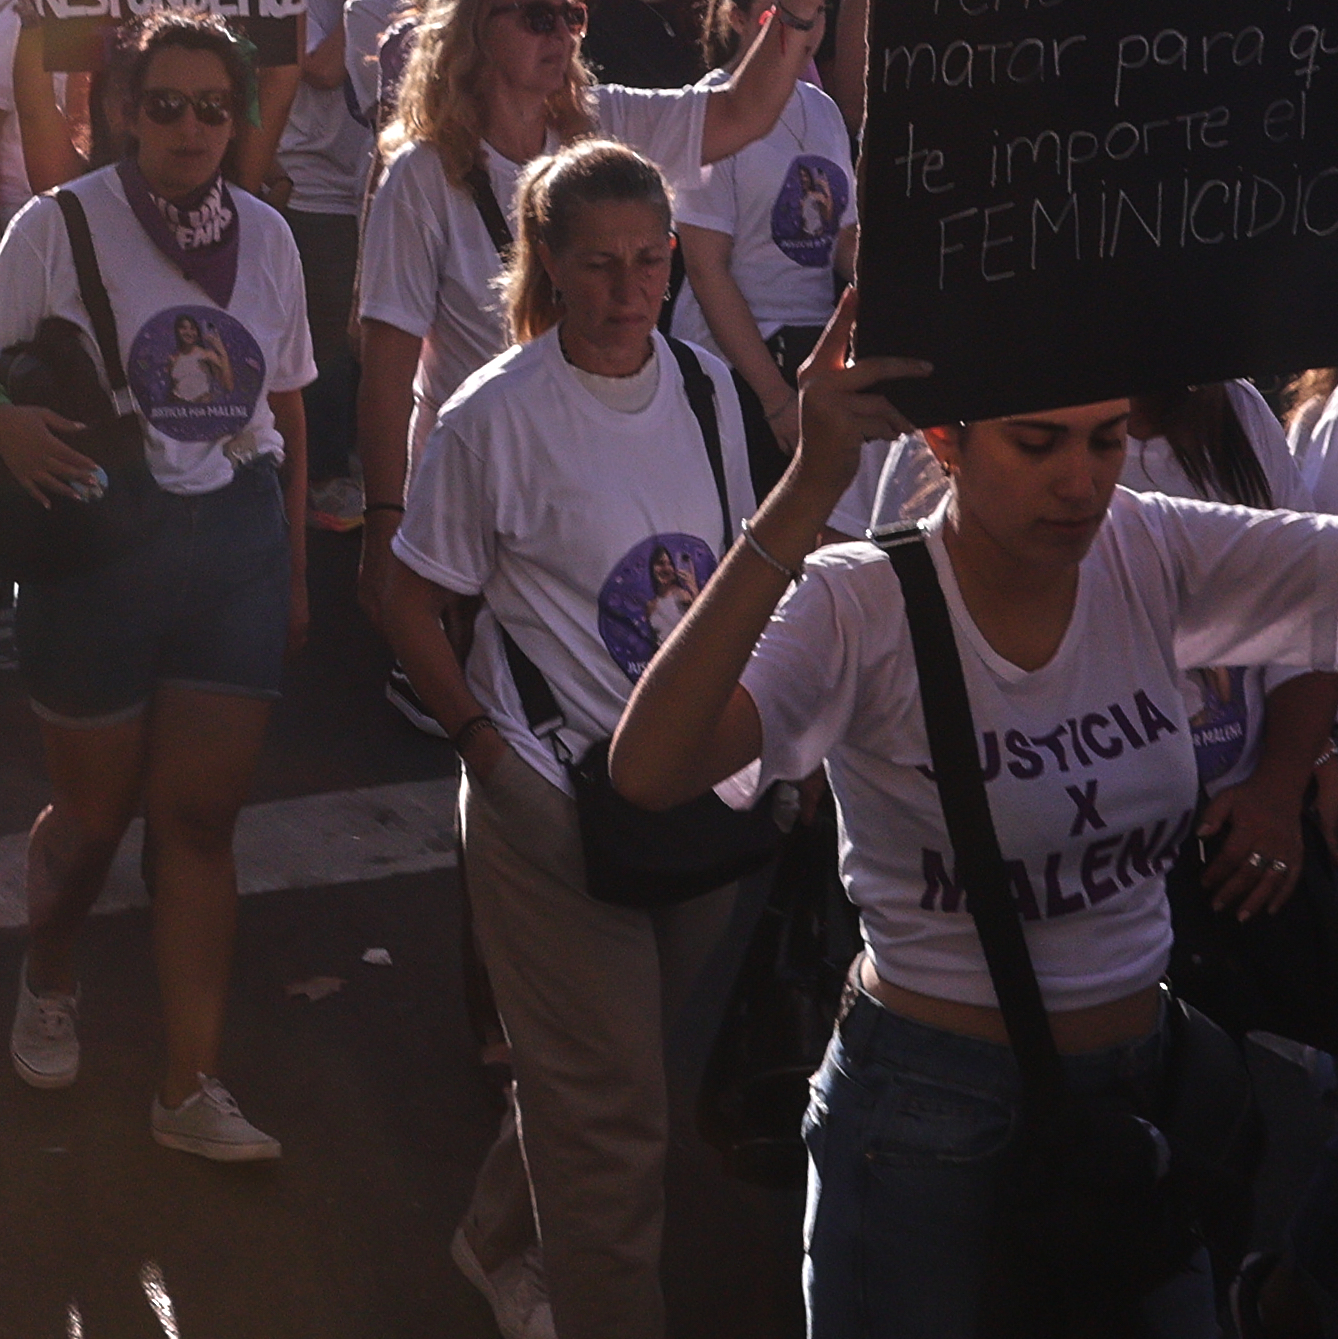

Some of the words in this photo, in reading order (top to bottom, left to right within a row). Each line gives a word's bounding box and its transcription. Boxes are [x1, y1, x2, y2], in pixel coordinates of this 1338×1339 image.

[1114, 24, 1265, 108] para
[895, 122, 955, 198] te
[991, 105, 1231, 195] importe
[1264, 89, 1307, 143] el
[916, 688, 1179, 782] USTICIA
[1066, 778, 1107, 837] X
